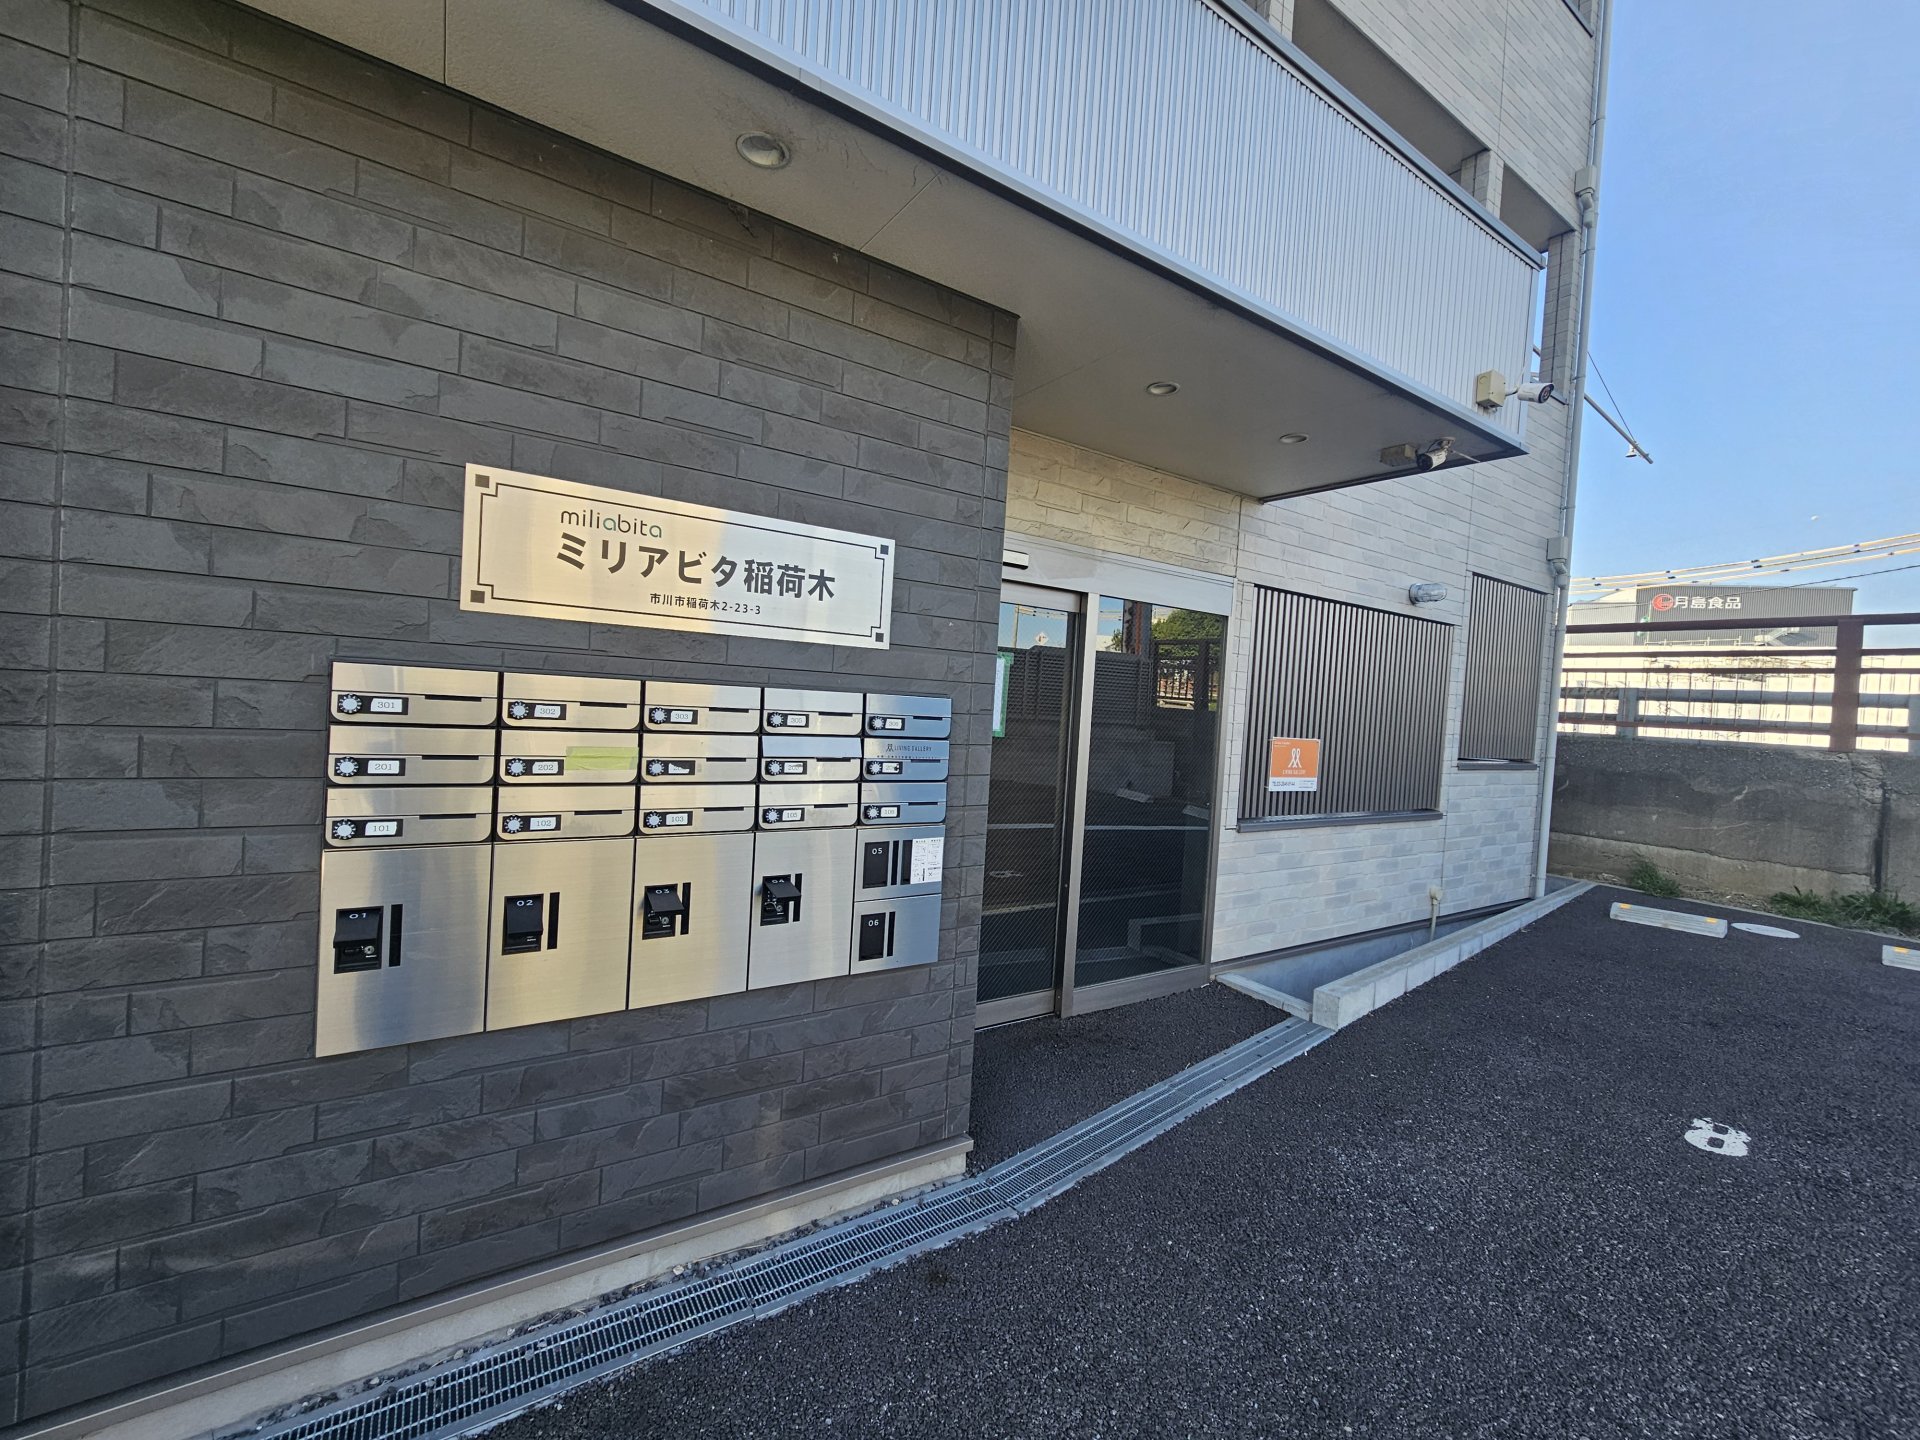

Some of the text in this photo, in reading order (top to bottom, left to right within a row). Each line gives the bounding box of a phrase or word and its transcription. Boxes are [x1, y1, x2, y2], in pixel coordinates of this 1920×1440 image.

[560, 508, 662, 539] miliabita
[556, 531, 836, 602] ミリアビタ稲荷木
[649, 592, 762, 615] 市川市稲荷木2-23-3
[1673, 596, 1742, 609] 月島食品
[377, 701, 395, 709] 301
[374, 763, 392, 771] 201
[373, 824, 390, 832] 101
[871, 847, 883, 855] 05
[516, 899, 534, 907] 02
[867, 919, 879, 927] 06
